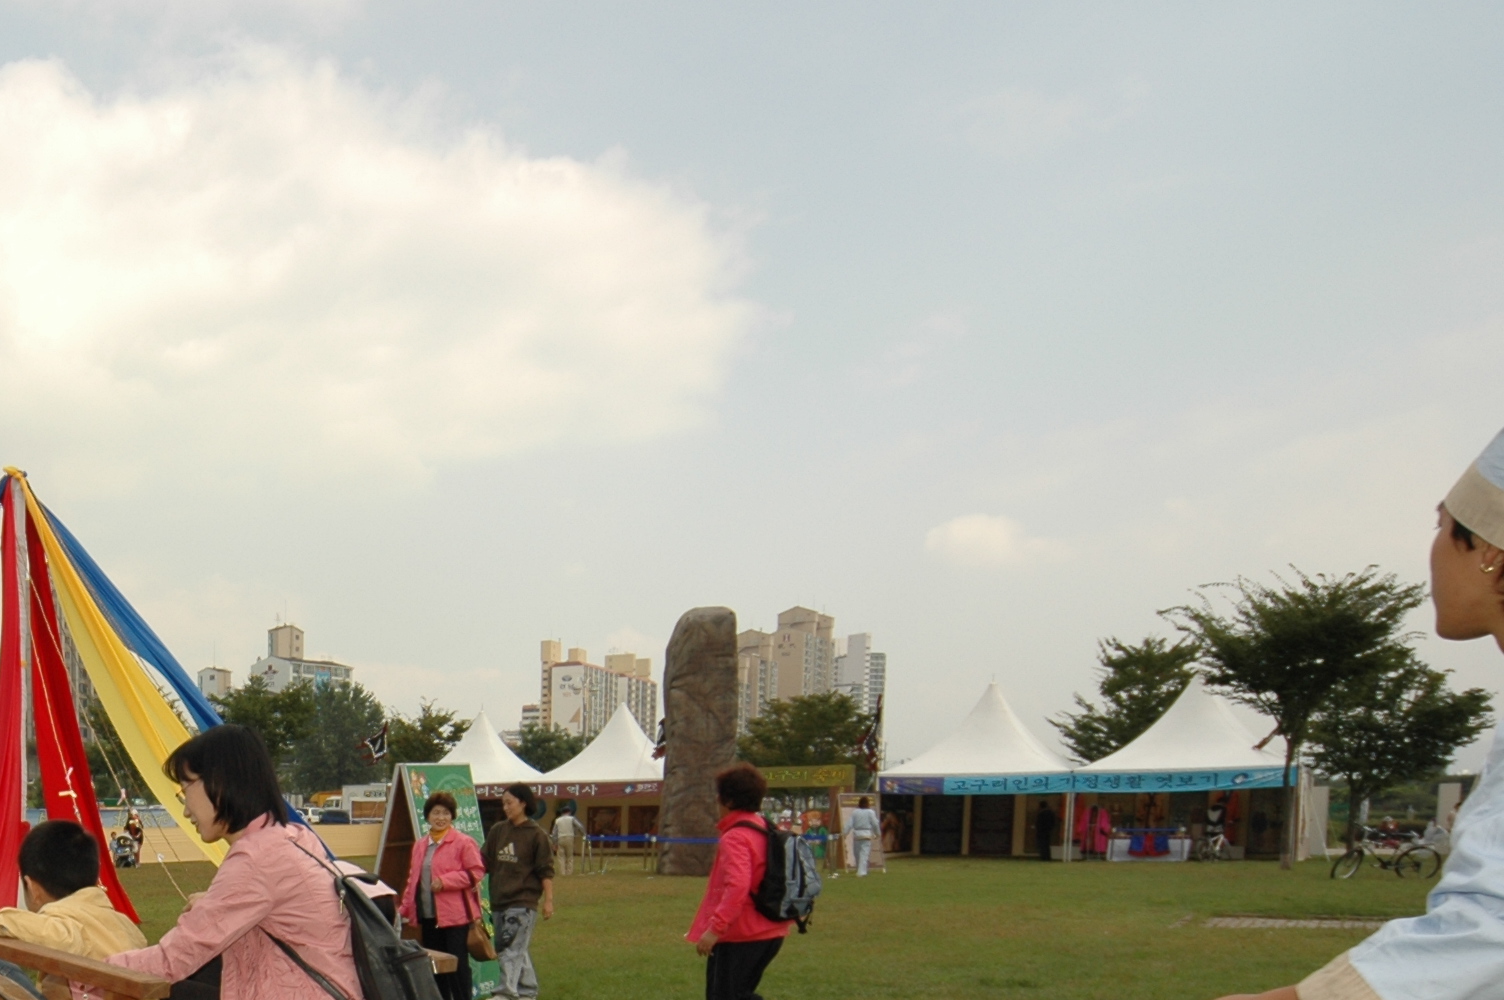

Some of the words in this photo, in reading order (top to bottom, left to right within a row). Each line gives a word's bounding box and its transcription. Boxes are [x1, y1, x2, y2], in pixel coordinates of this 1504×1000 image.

[950, 776, 1049, 791] 고구려인의
[1060, 774, 1145, 789] 가정생활
[1155, 773, 1219, 788] 엿보기
[476, 785, 505, 797] 려는
[529, 784, 558, 796] 리의
[567, 784, 599, 796] 역사
